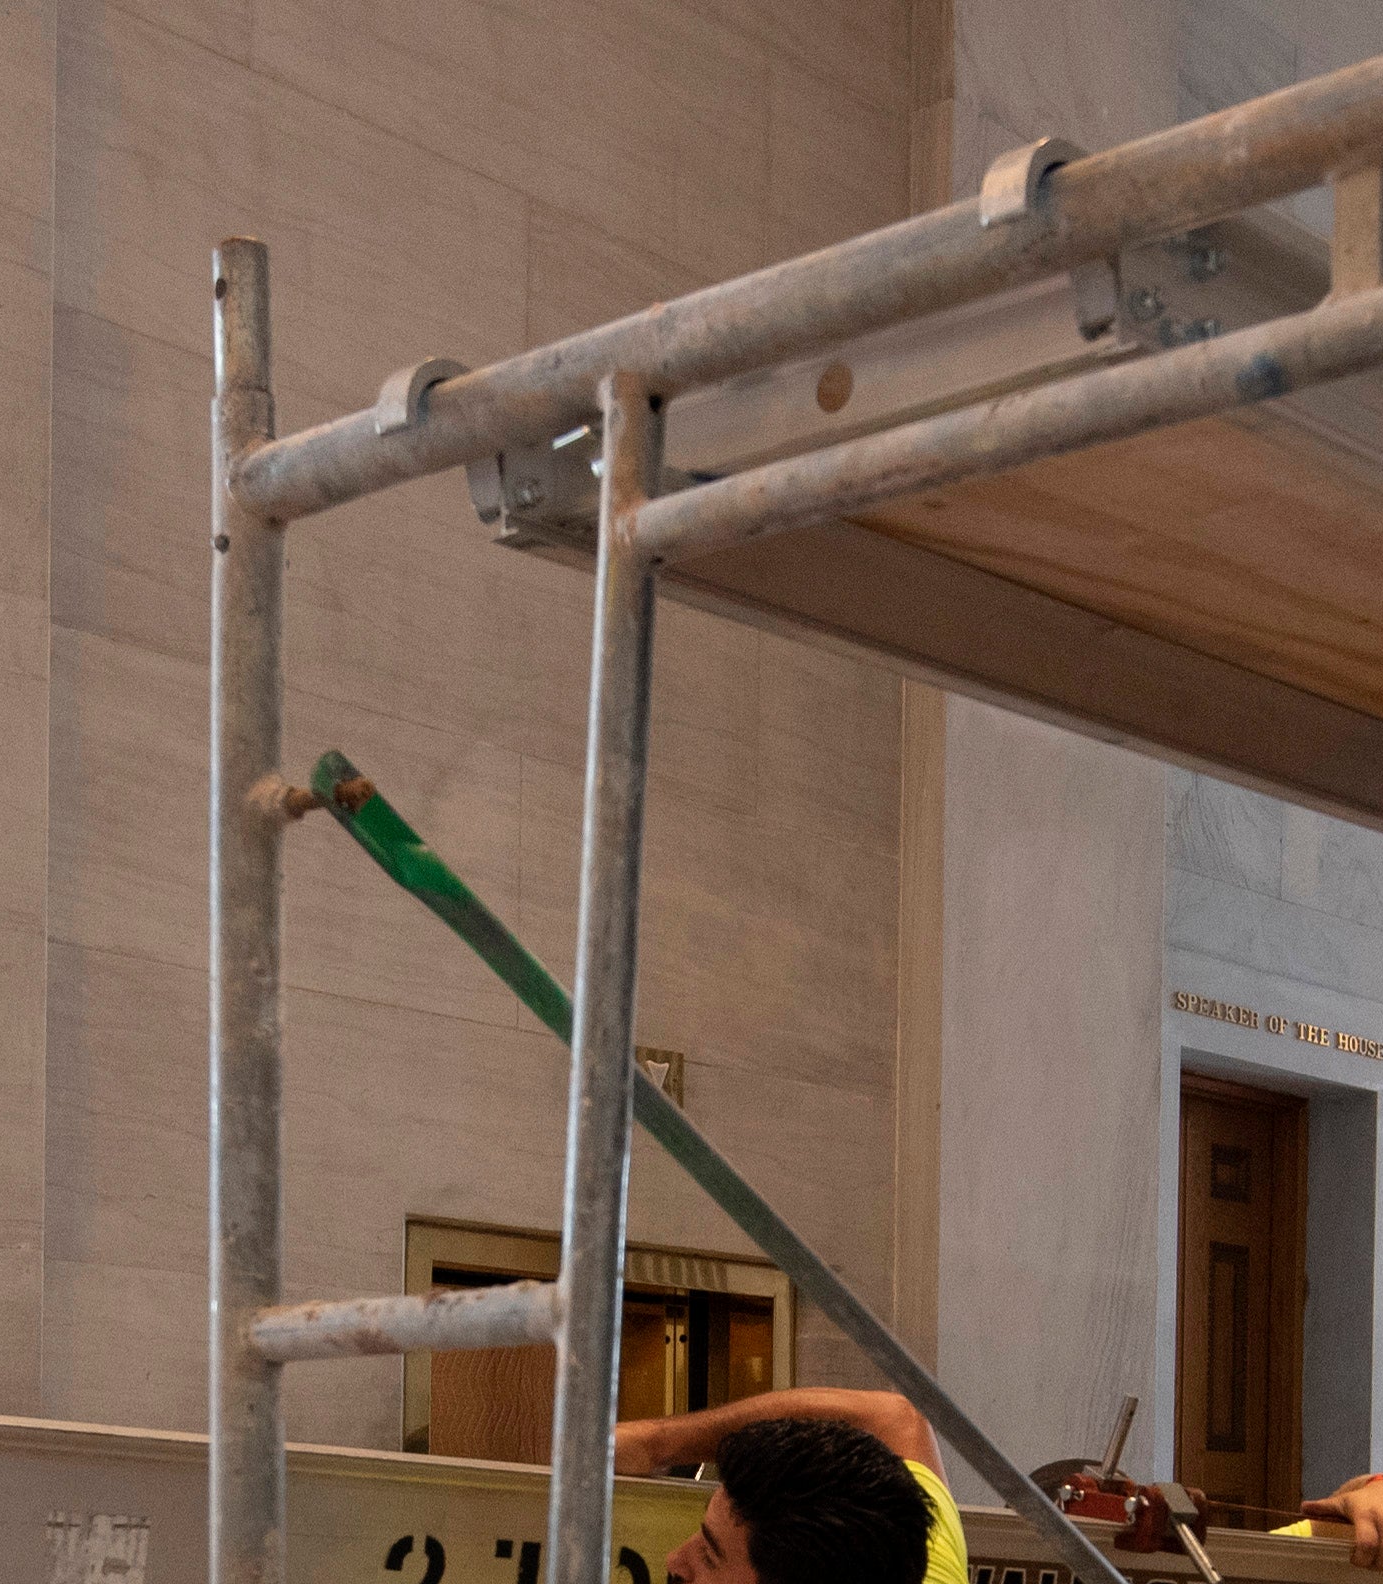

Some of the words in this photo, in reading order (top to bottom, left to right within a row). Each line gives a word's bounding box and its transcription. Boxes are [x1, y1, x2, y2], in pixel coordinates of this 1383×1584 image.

[1174, 991, 1260, 1029] SPEAKER
[1266, 1014, 1289, 1035] OF
[1297, 1021, 1330, 1047] THE
